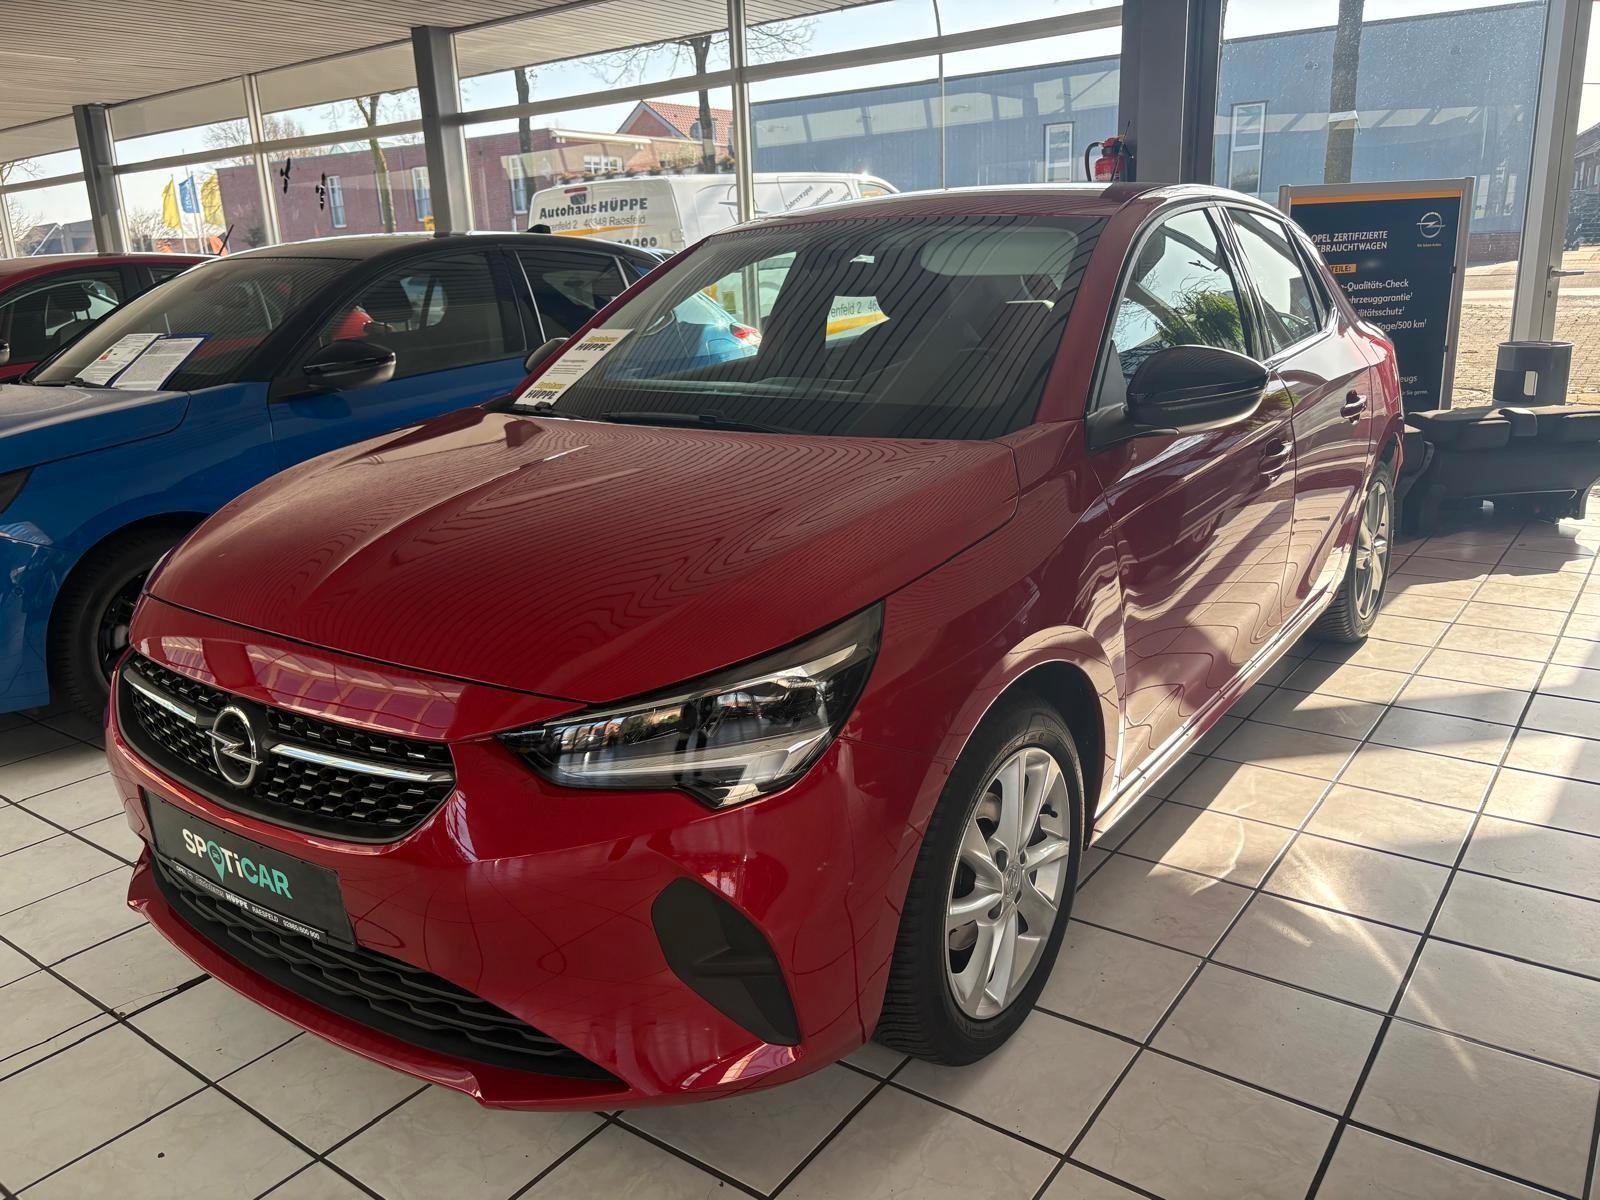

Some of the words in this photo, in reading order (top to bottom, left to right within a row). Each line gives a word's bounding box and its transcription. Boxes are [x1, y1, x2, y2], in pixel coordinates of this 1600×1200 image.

[539, 204, 597, 220] Autohaus
[598, 197, 648, 213] HÜPPE
[1311, 234, 1331, 244] OPEL
[1333, 230, 1388, 242] ZERTIFIZIERTE
[1317, 241, 1388, 253] BRAUCHTWAGEN
[1330, 265, 1351, 273] TEILE:
[1340, 279, 1409, 291] -Qualitäts-Check
[831, 302, 855, 318] enfeld
[856, 301, 862, 314] 2
